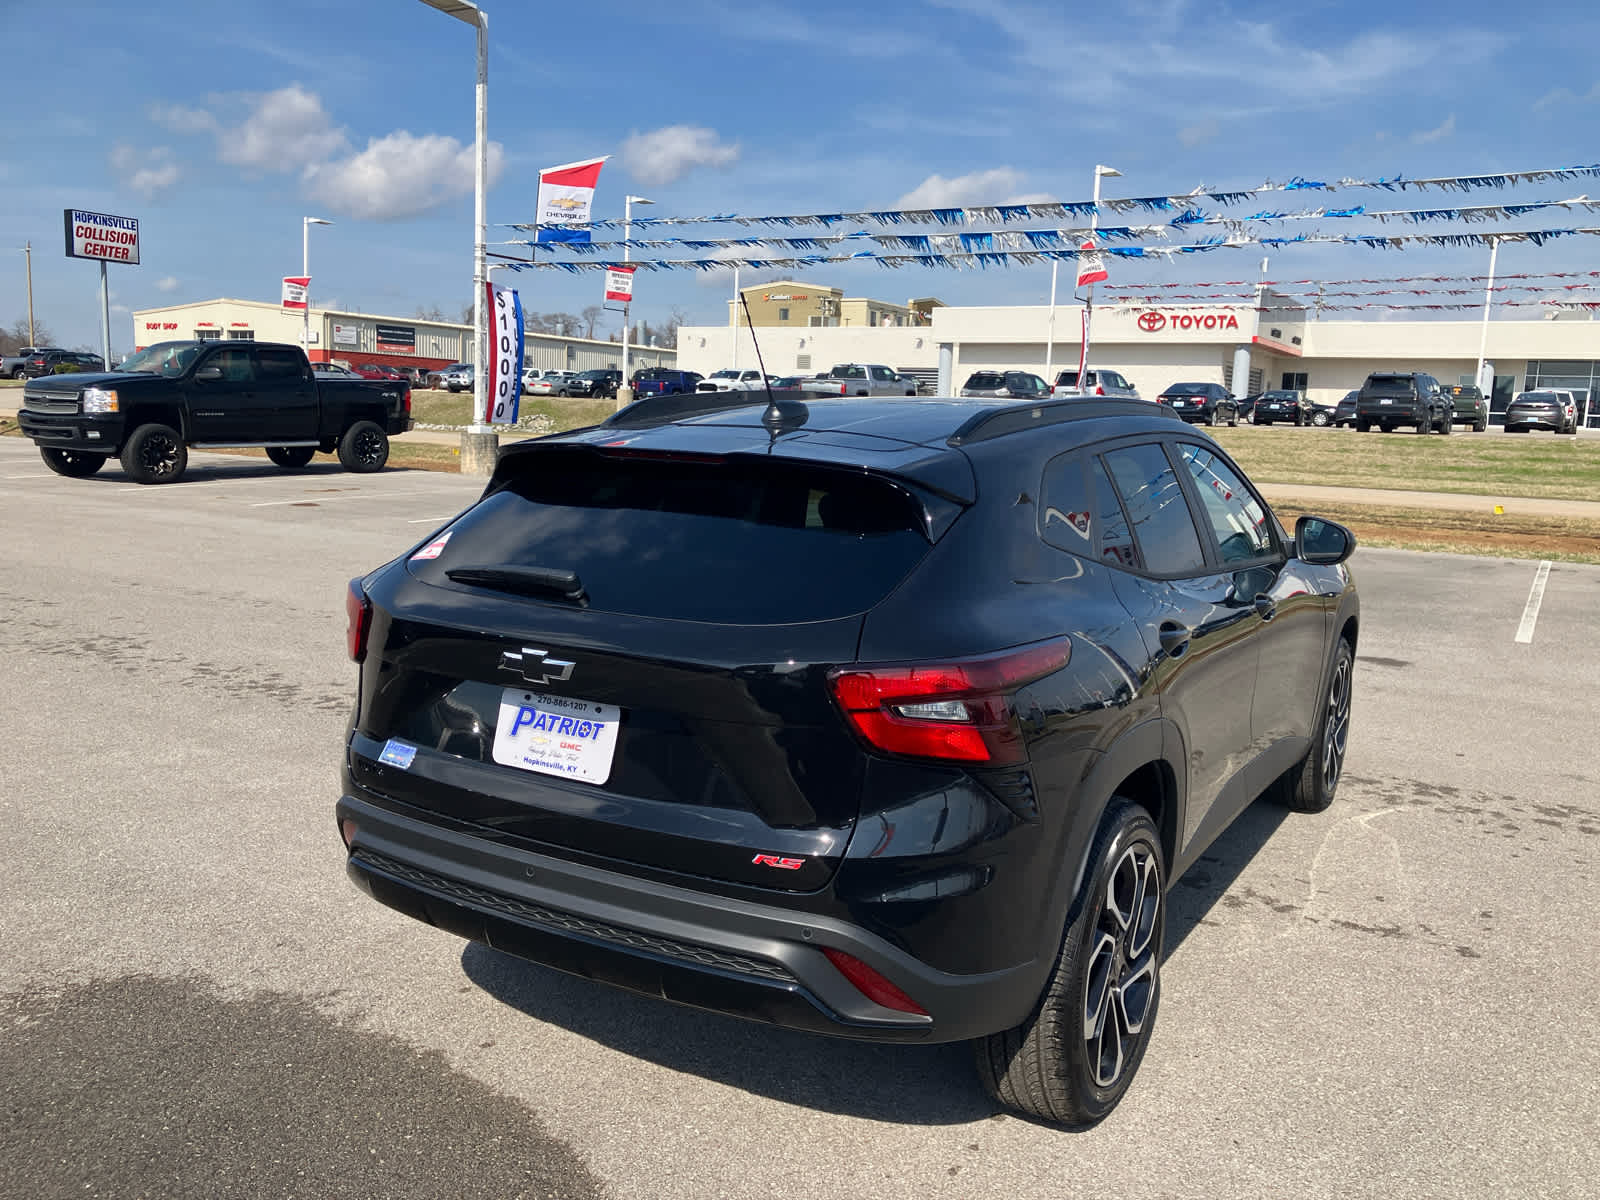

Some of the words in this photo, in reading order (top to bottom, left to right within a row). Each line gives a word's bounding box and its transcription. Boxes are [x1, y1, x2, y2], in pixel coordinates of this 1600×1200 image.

[75, 212, 137, 231] HOPKINSVILLE
[546, 211, 587, 220] CHEVROLET
[75, 225, 137, 246] COLLISION
[84, 242, 130, 260] CENTER
[1170, 315, 1239, 330] TOYOTA
[537, 695, 588, 712] 270-886-1207
[510, 706, 605, 741] PATRIOT
[559, 742, 582, 752] GMC
[523, 756, 566, 772] Hopkinsville,
[566, 765, 578, 773] KY
[752, 854, 806, 870] RS
